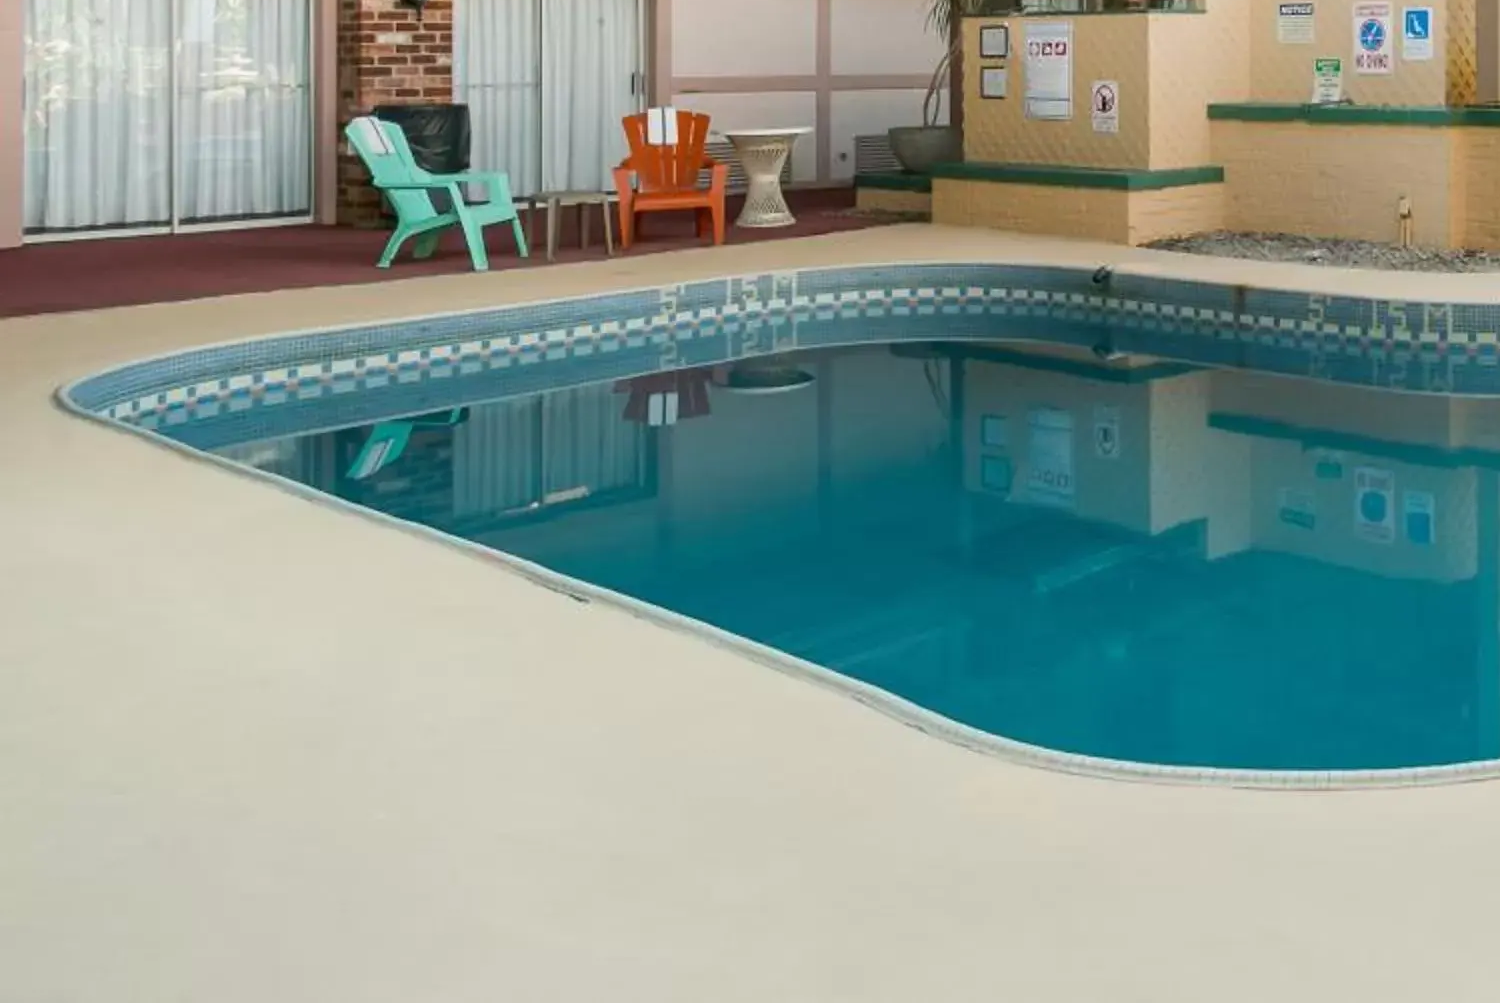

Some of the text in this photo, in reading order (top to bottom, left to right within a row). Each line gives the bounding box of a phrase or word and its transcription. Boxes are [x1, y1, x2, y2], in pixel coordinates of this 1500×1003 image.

[1281, 5, 1312, 15] NOTICE
[1356, 54, 1364, 69] NO
[1366, 54, 1389, 69] DIVING
